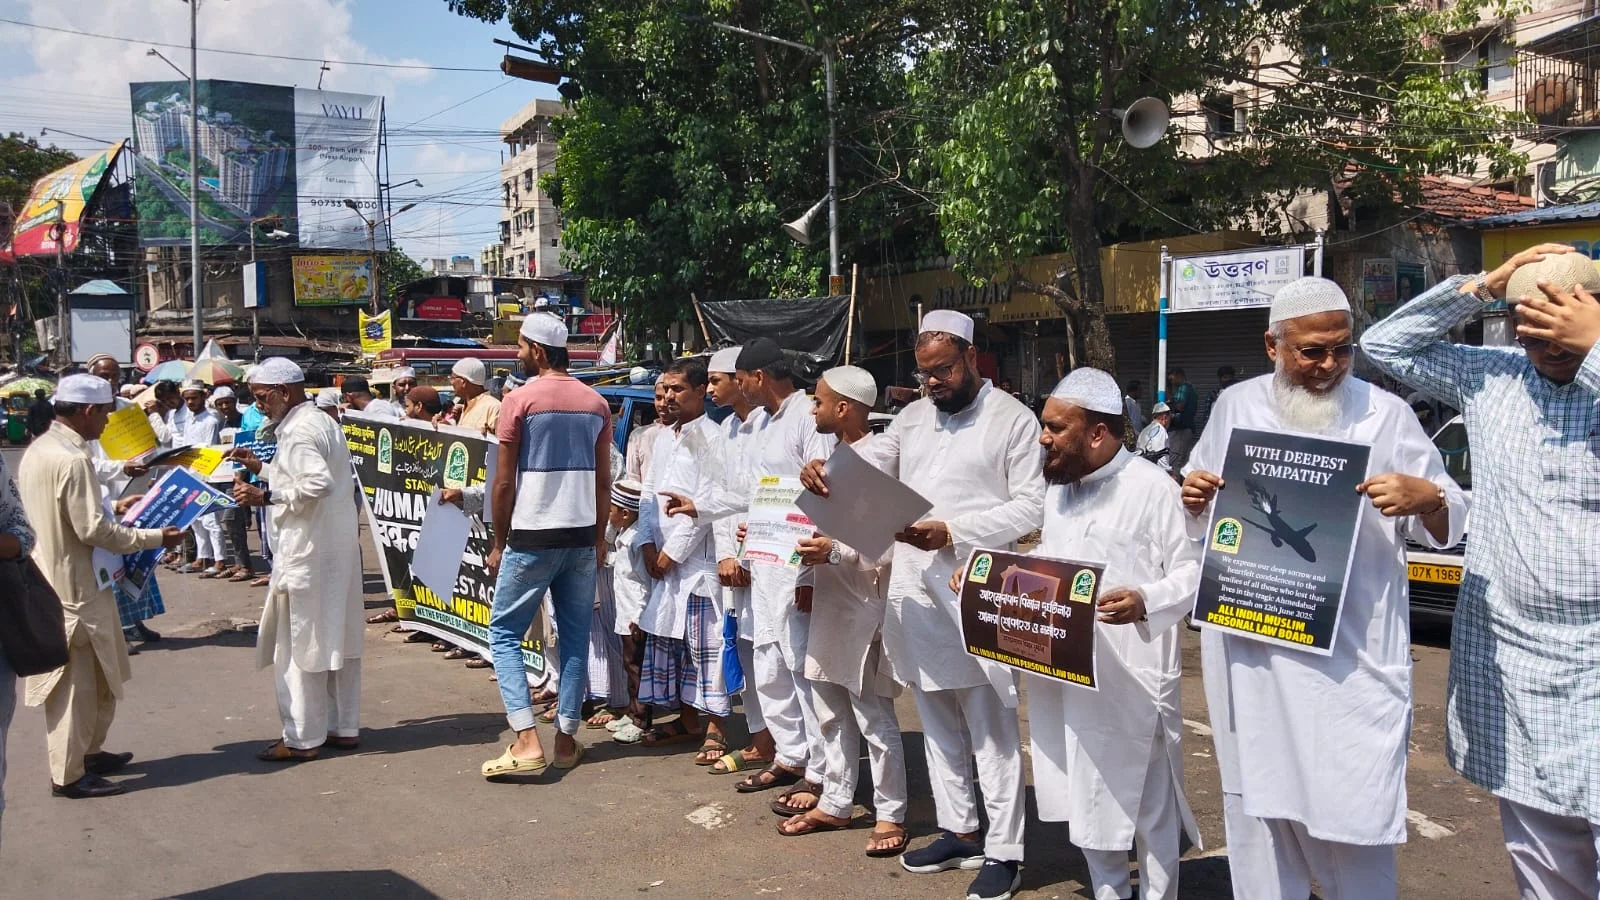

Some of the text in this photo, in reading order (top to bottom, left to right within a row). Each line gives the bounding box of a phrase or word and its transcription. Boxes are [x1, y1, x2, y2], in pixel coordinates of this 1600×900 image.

[321, 103, 362, 120] VAYU
[310, 198, 377, 209] 90733000
[1203, 258, 1270, 278] উত্তরণ
[1244, 444, 1347, 471] WITH DEEPEST
[1251, 462, 1333, 486] SYMPATHY
[374, 487, 431, 521] HUMA
[1221, 555, 1326, 583] We express our deep sorrow and
[1227, 566, 1317, 591] heartfelt condolences to the
[1412, 566, 1461, 582] 07K 1969
[1218, 573, 1242, 585] families
[1243, 578, 1251, 586] of
[1250, 580, 1260, 589] all
[1260, 582, 1279, 593] those
[1279, 586, 1294, 596] who
[1294, 590, 1308, 599] lost
[1221, 584, 1317, 611] lives in the tragic Ahmedabad
[412, 584, 493, 626] WAQ MEND
[1019, 593, 1040, 611] বিমান
[1218, 594, 1314, 621] plane crash on 12th June 2025.
[425, 608, 436, 621] THE
[436, 611, 455, 625] PEOPLE
[454, 617, 462, 628] OF
[462, 620, 476, 634] INDIA
[1001, 616, 1030, 632] শোকাহত
[1032, 621, 1039, 634] ও
[1207, 612, 1314, 645] PERSONAL LAW BOARD
[1217, 604, 1306, 632] ALL INDIA MUSLIM
[969, 645, 1091, 684] ALL INDIA MUSLIM PERSONAL LAW BOARD
